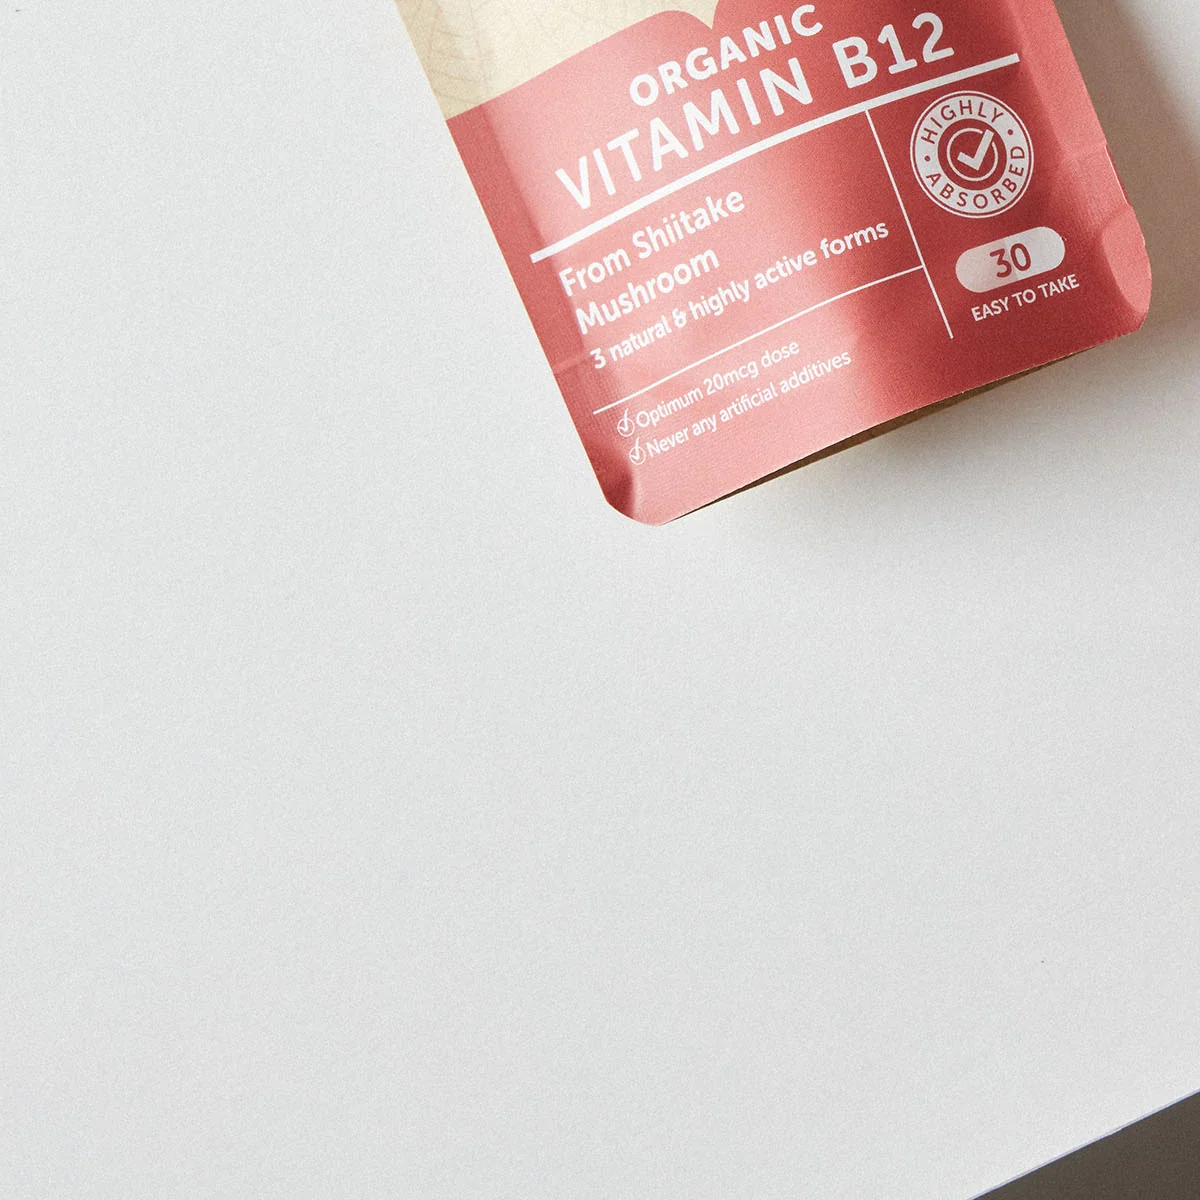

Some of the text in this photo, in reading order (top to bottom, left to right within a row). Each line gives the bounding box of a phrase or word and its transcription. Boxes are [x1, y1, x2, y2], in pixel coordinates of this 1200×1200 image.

[628, 3, 824, 107] ORGANIC
[555, 11, 956, 211] VITAMIN B12
[920, 99, 1005, 145] HIGHLY
[926, 145, 1026, 210] ABSORBED
[558, 190, 746, 297] From Shiitake
[989, 242, 1032, 279] 30
[575, 249, 720, 336] Mushroom
[589, 221, 890, 370] 3 natural & highly active forms
[970, 273, 1080, 323] EASY TO TAKE
[635, 340, 800, 429] Optimum 20mcg dose
[645, 350, 852, 458] Never any artificial additives
